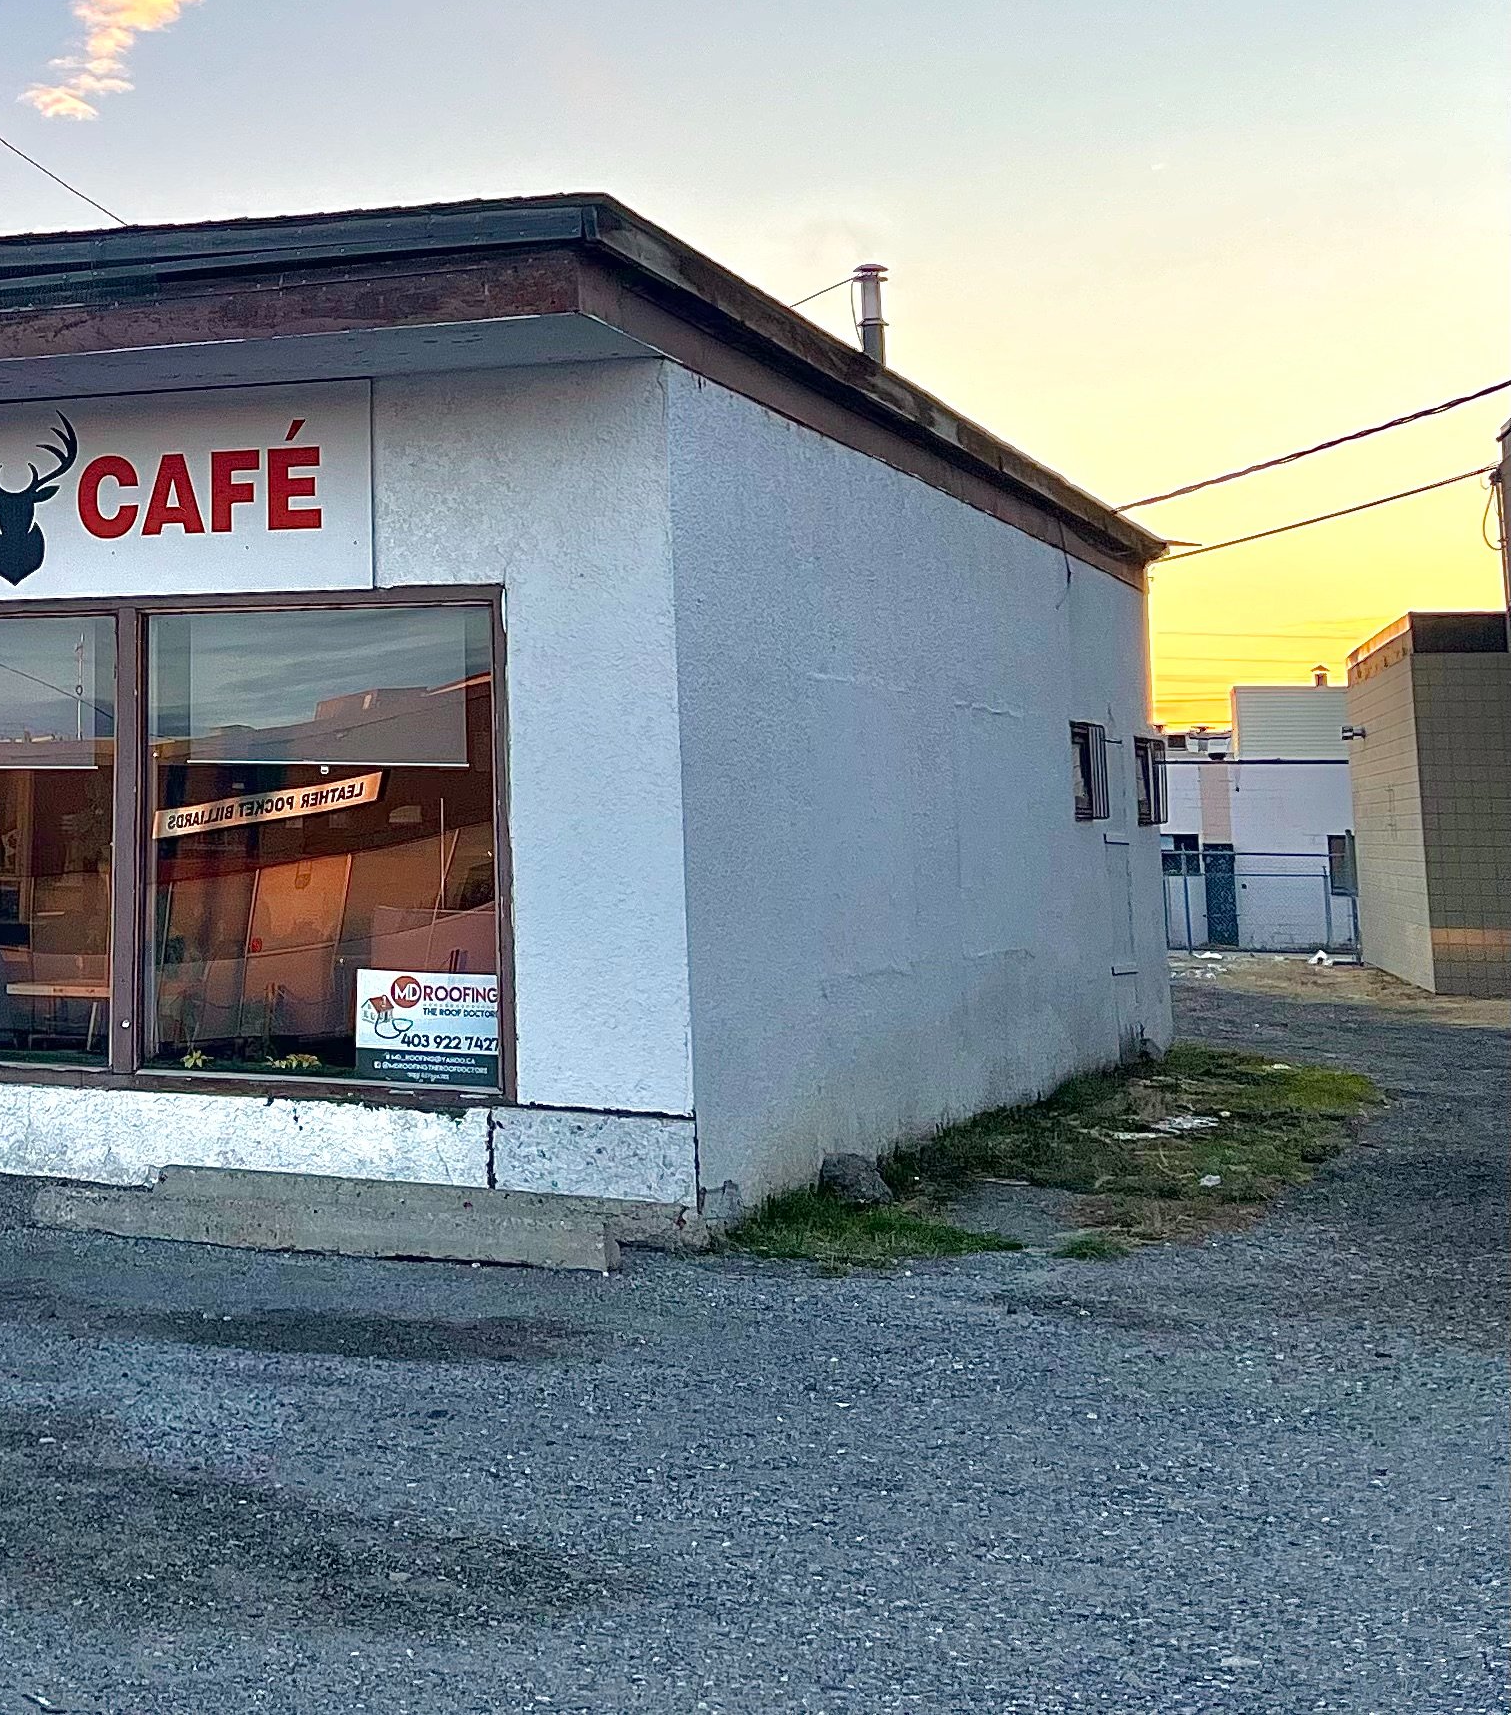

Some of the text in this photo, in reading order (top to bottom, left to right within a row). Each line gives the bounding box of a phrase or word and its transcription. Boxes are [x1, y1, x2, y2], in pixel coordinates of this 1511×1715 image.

[76, 417, 324, 540] CAFÉ
[393, 981, 498, 1004] MD ROOFING
[422, 1007, 438, 1016] THE
[439, 1008, 462, 1017] ROOF
[400, 1033, 499, 1052] 403 922 7427
